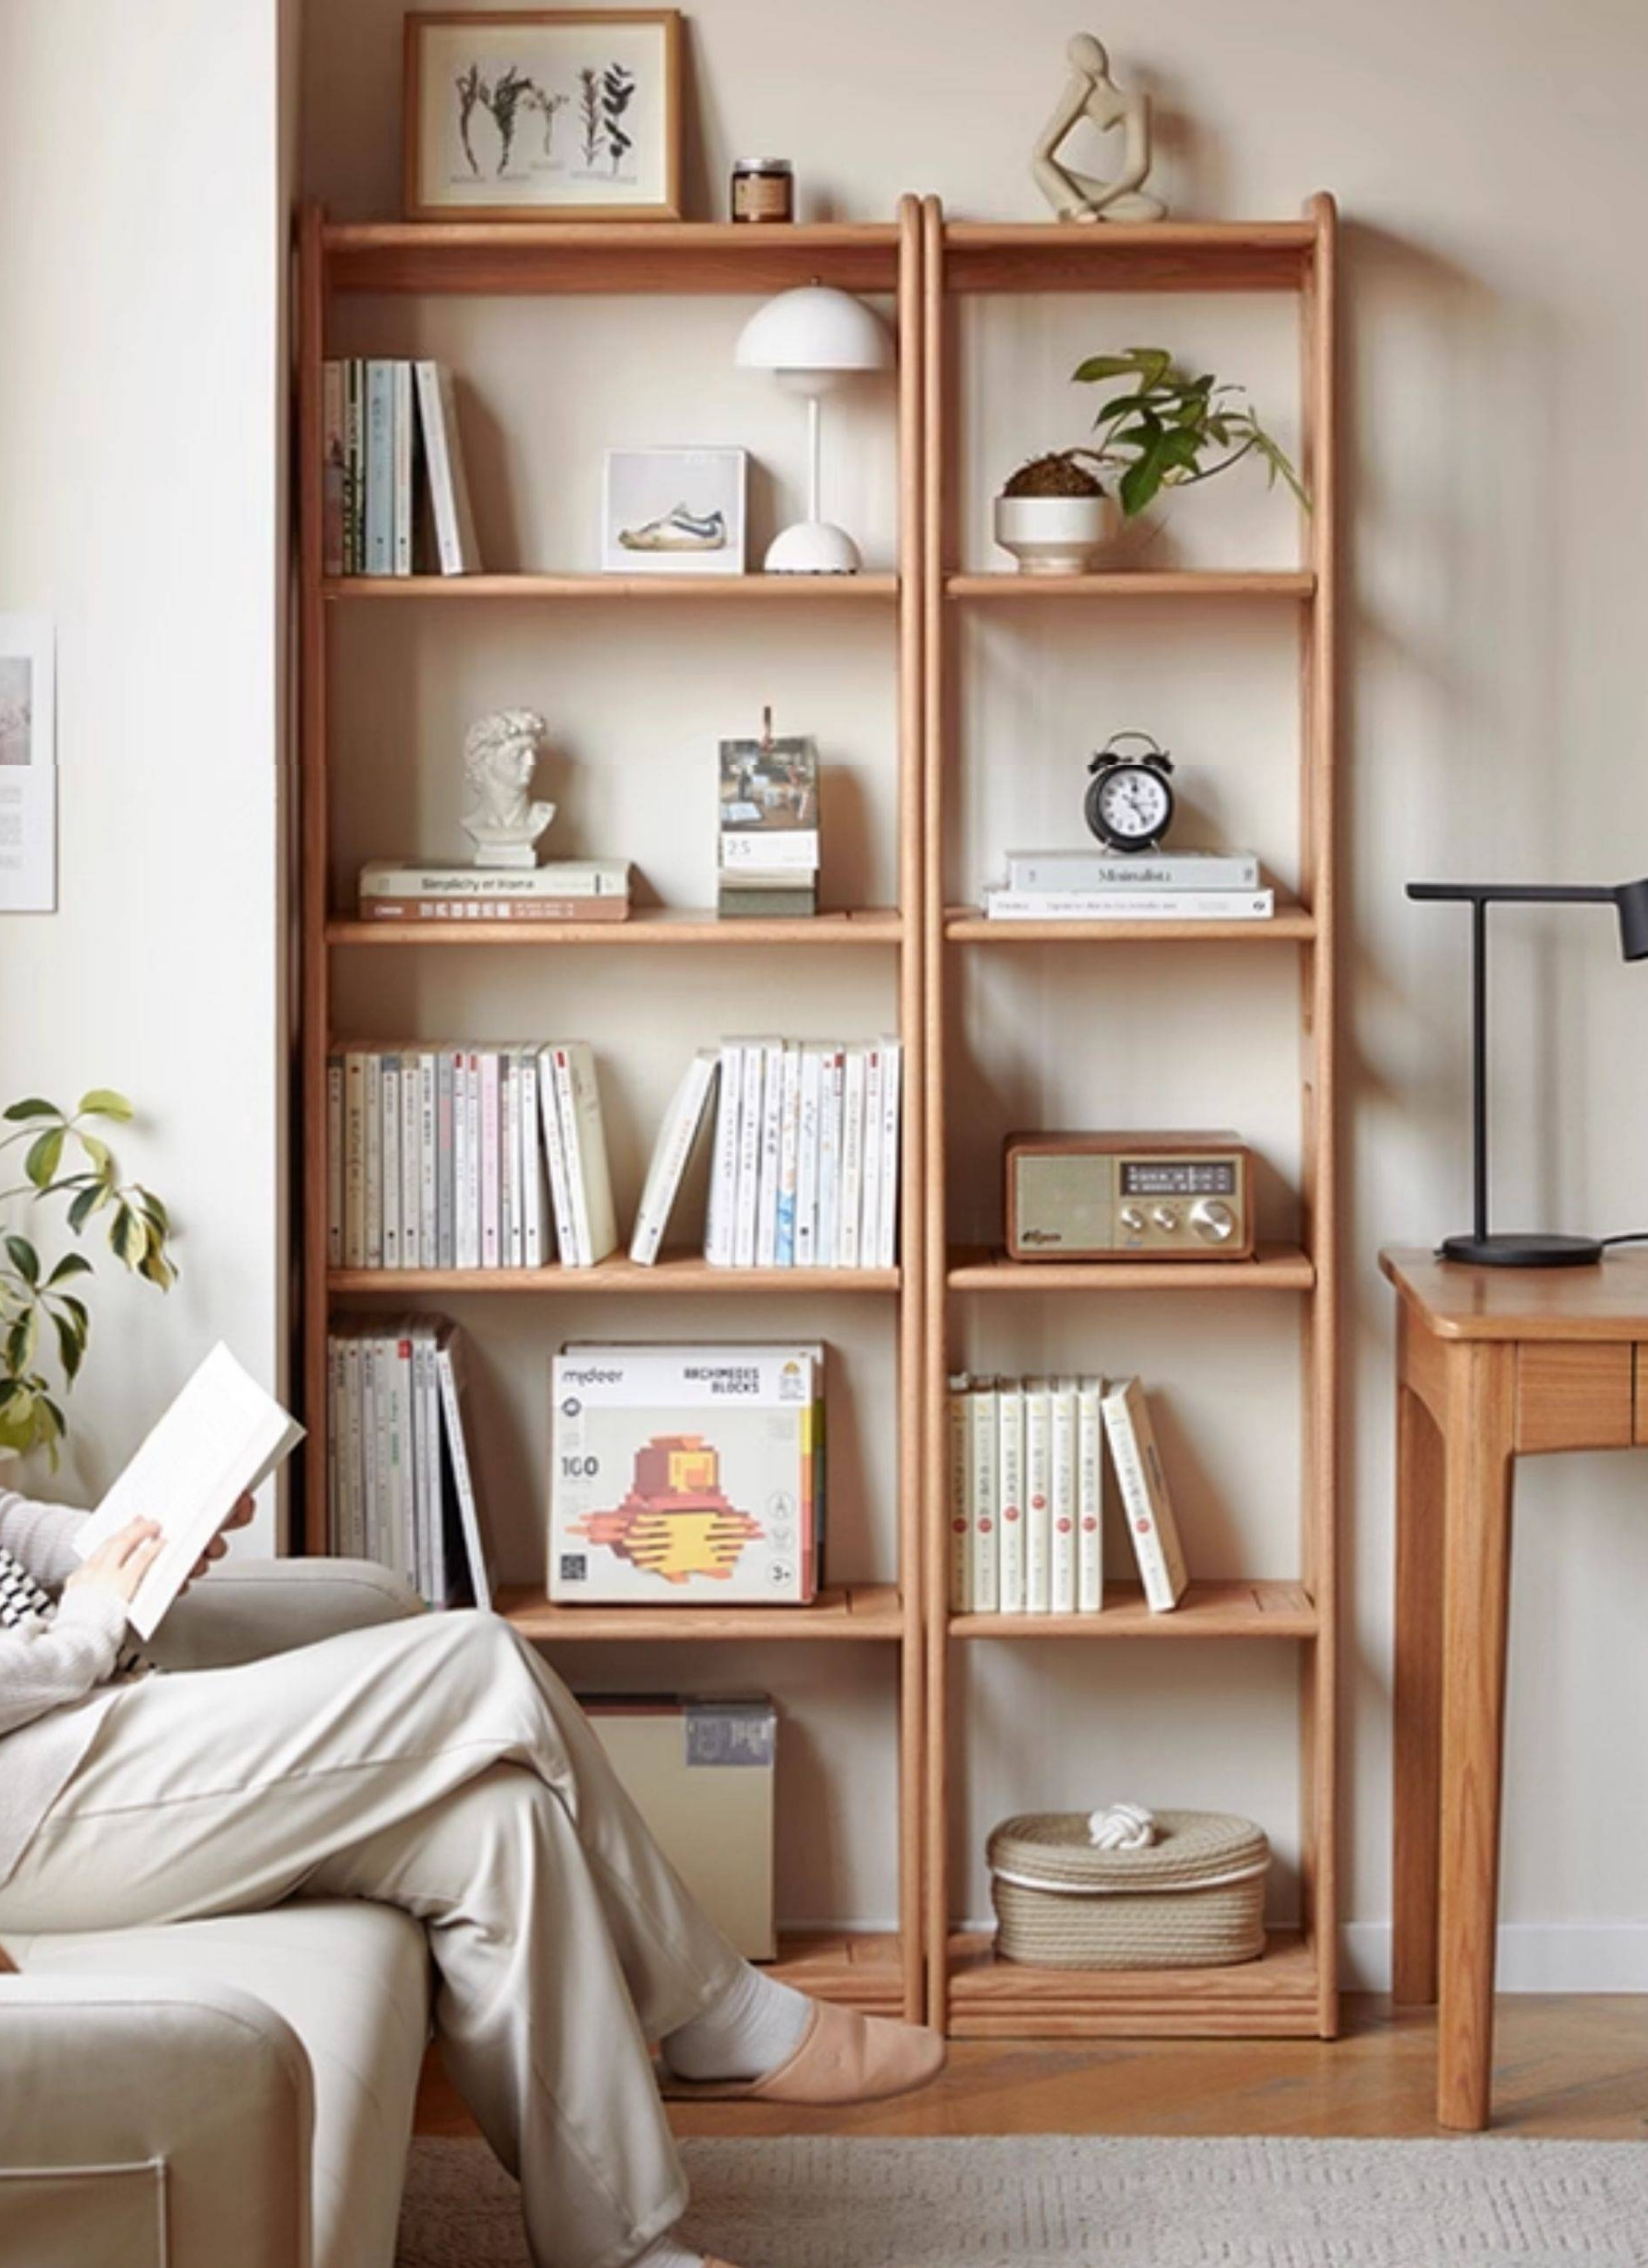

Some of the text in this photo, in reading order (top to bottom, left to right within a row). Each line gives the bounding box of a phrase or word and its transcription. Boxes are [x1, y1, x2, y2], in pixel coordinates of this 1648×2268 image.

[562, 1366, 623, 1387] mydeer
[684, 1367, 759, 1379] ARCHIMEDES
[712, 1381, 759, 1393] BLOCKS
[561, 1455, 599, 1477] 100
[773, 1565, 791, 1581] 3+
